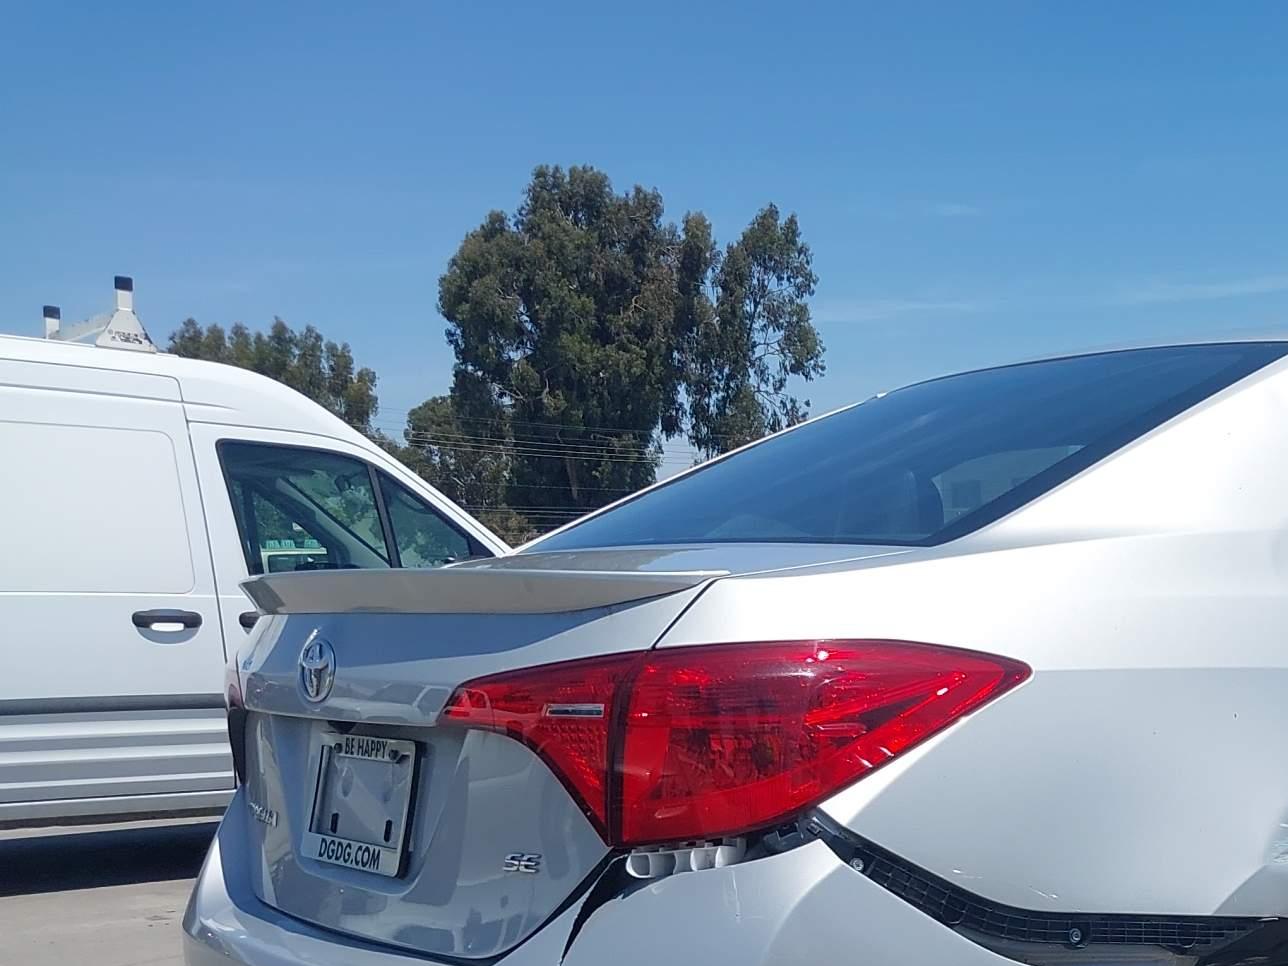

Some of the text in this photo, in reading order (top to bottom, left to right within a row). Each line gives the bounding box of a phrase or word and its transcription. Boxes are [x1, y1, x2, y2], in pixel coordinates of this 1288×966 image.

[344, 737, 388, 759] BE HAPPY
[318, 837, 381, 870] DGDG.COM
[503, 852, 541, 873] SE
